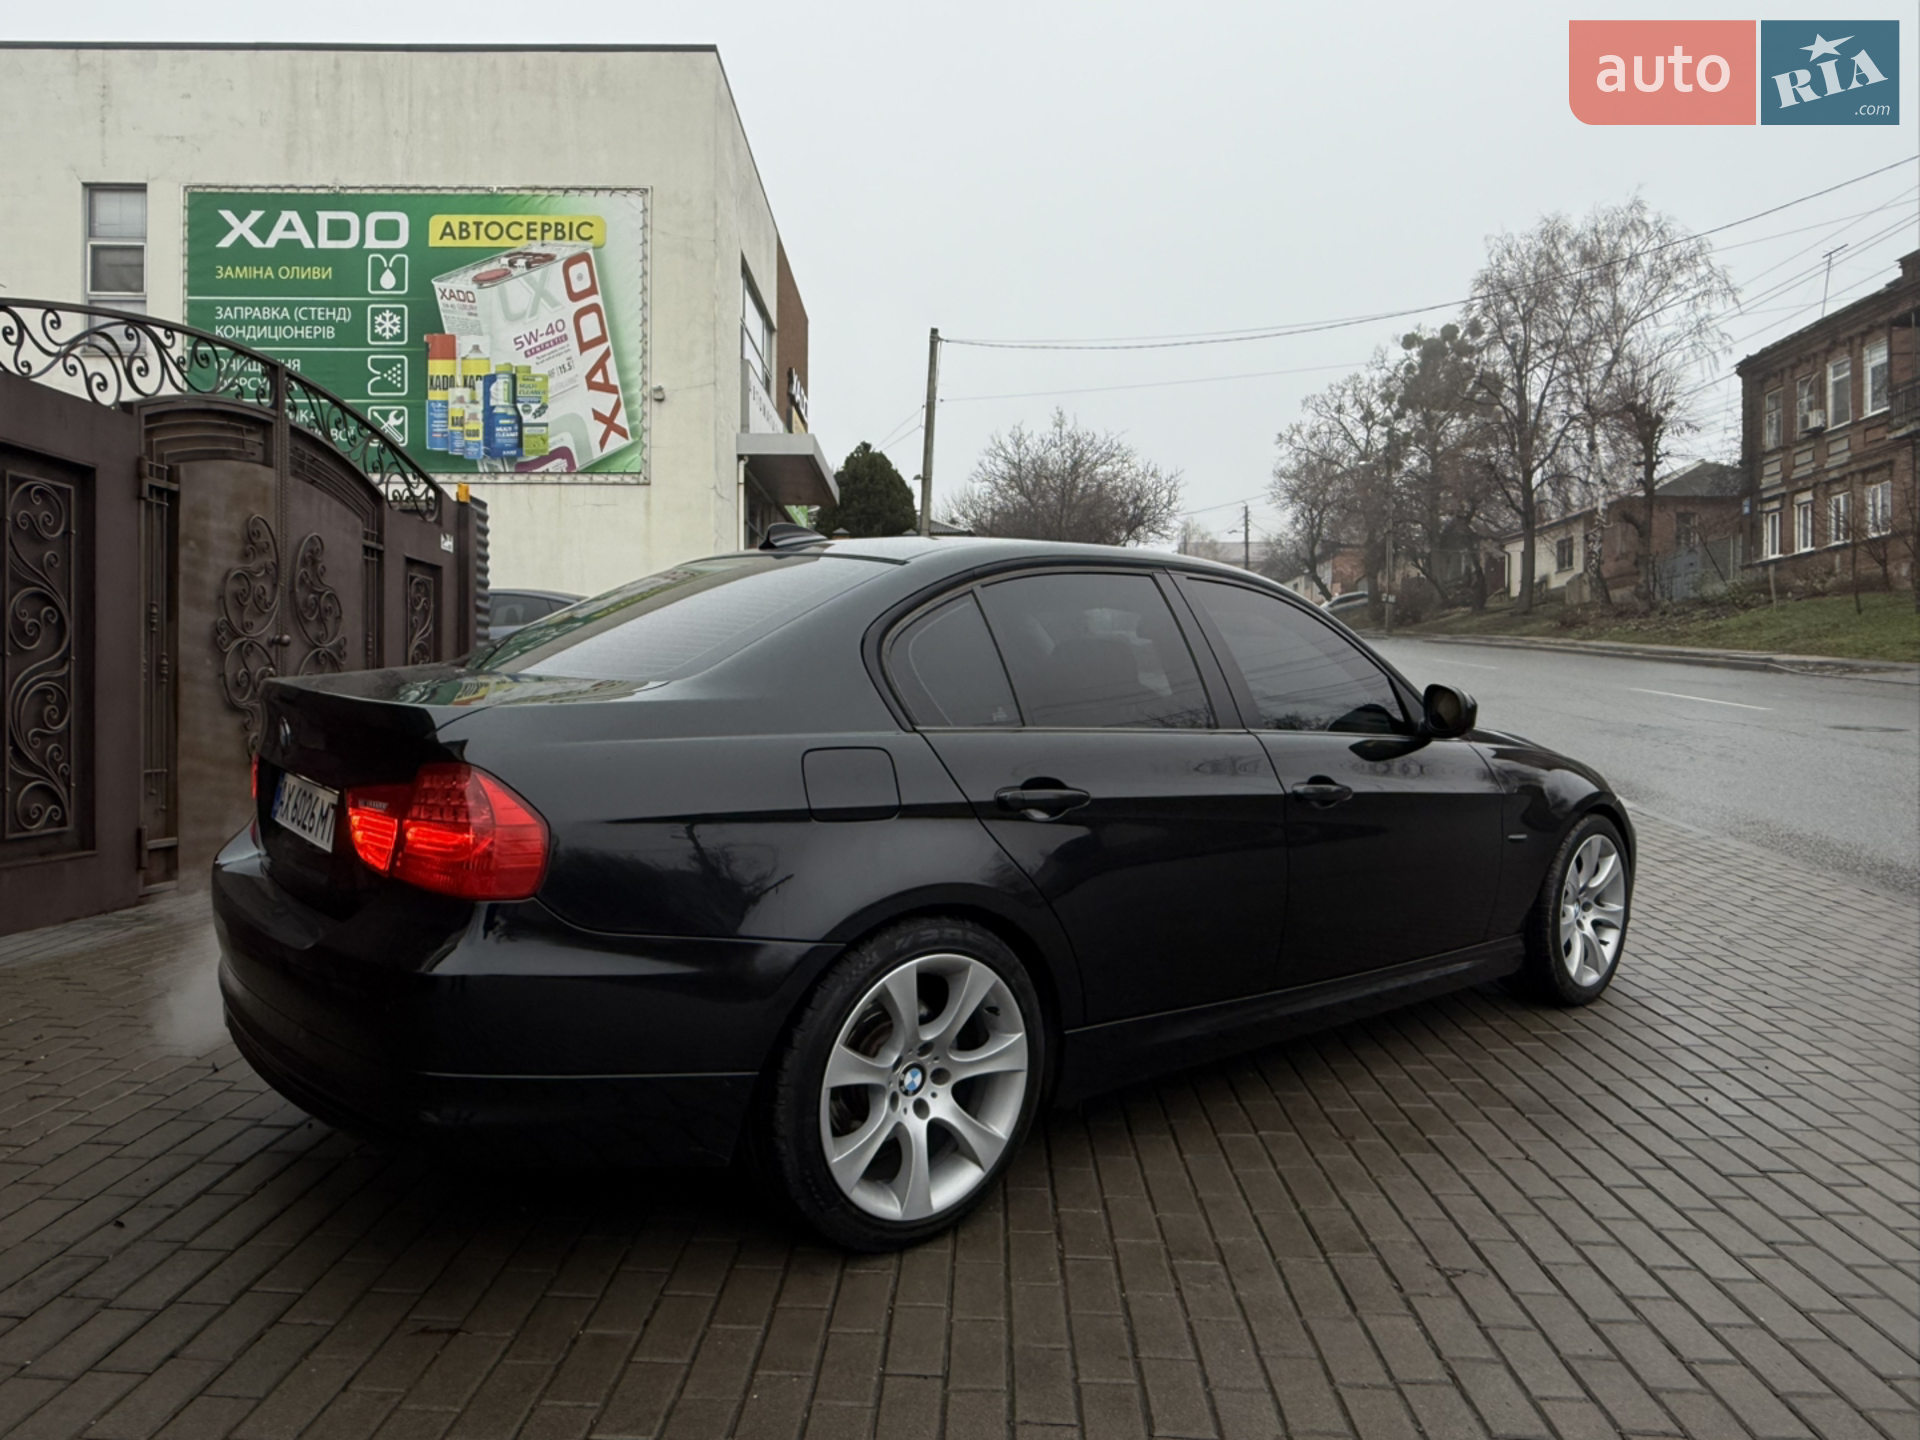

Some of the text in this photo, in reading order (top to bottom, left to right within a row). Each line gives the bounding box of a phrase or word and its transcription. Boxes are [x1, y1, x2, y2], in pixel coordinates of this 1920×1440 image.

[215, 209, 410, 249] XADO
[438, 220, 595, 242] АВТОСЕРВІС
[215, 265, 333, 280] ЗАМІНА ОЛИВИ
[215, 306, 352, 323] ЗАПРАВКА (СТЕНД)
[215, 325, 336, 341] КОНДИЦІОНЕРІВ
[513, 318, 566, 351] 5W-40
[561, 251, 630, 454] XADO
